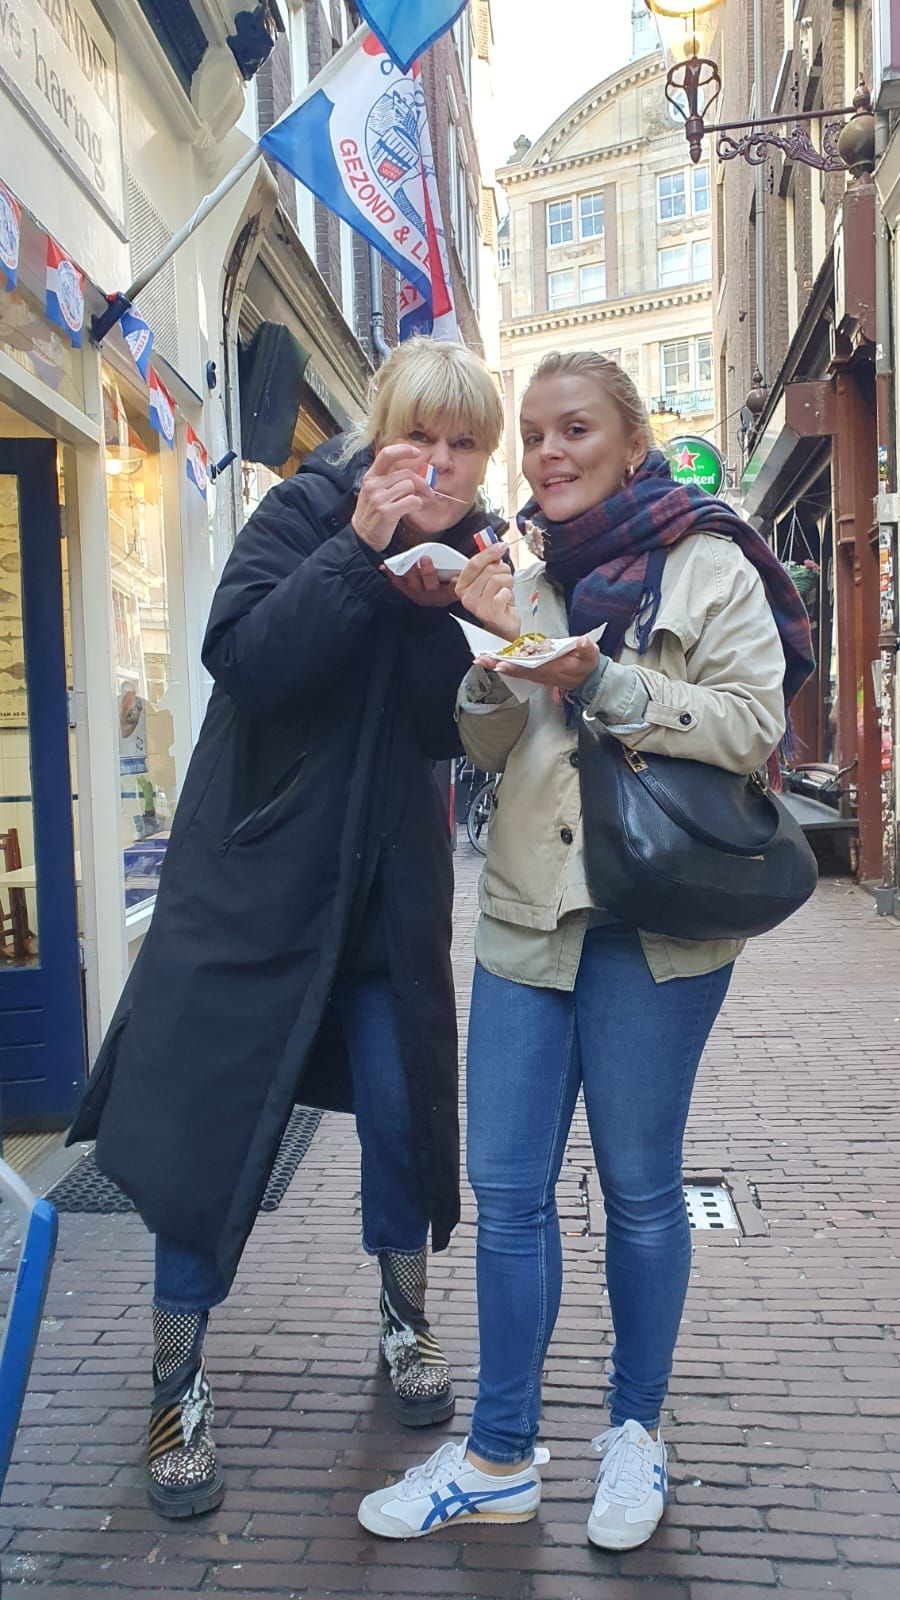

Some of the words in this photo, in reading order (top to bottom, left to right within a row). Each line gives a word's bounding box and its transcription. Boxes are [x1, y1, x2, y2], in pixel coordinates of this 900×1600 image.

[32, 28, 105, 192] haring
[37, 0, 116, 127] ANDEL
[340, 138, 396, 224] GEZOND
[393, 226, 411, 245] &
